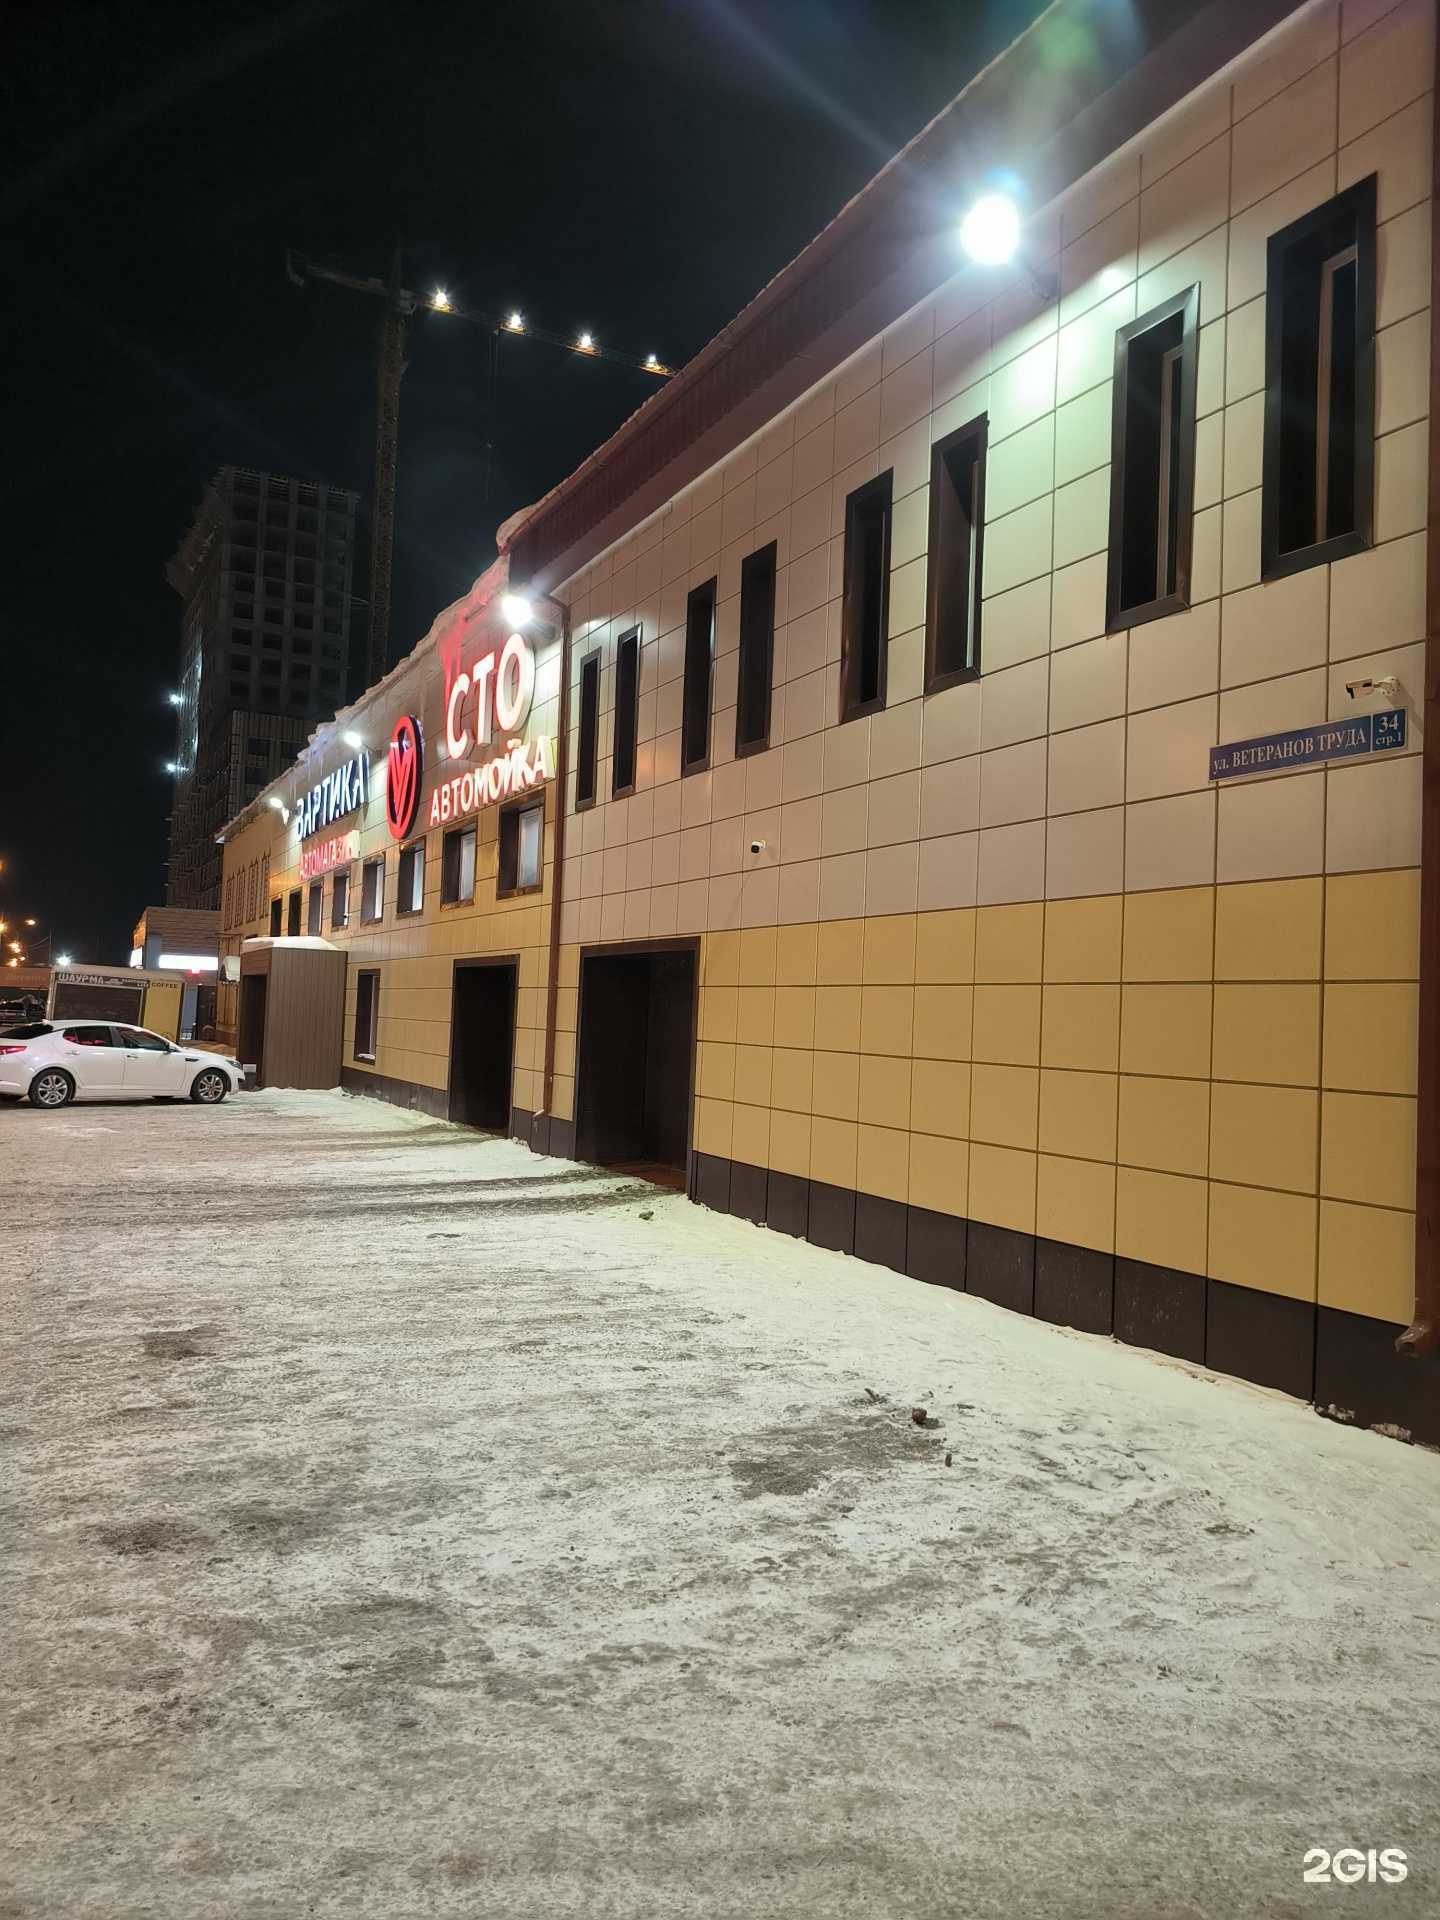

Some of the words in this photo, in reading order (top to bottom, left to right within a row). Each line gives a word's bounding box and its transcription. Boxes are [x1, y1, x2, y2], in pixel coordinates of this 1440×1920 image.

[446, 633, 534, 759] СТО
[1378, 714, 1399, 733] 34
[1213, 756, 1229, 774] ул.
[1233, 740, 1313, 767] ВЕТЕРАНОВ
[1317, 728, 1367, 754] ТРУДА
[430, 735, 556, 826] АВТОМОЙКА
[58, 972, 104, 985] ШАУРМА
